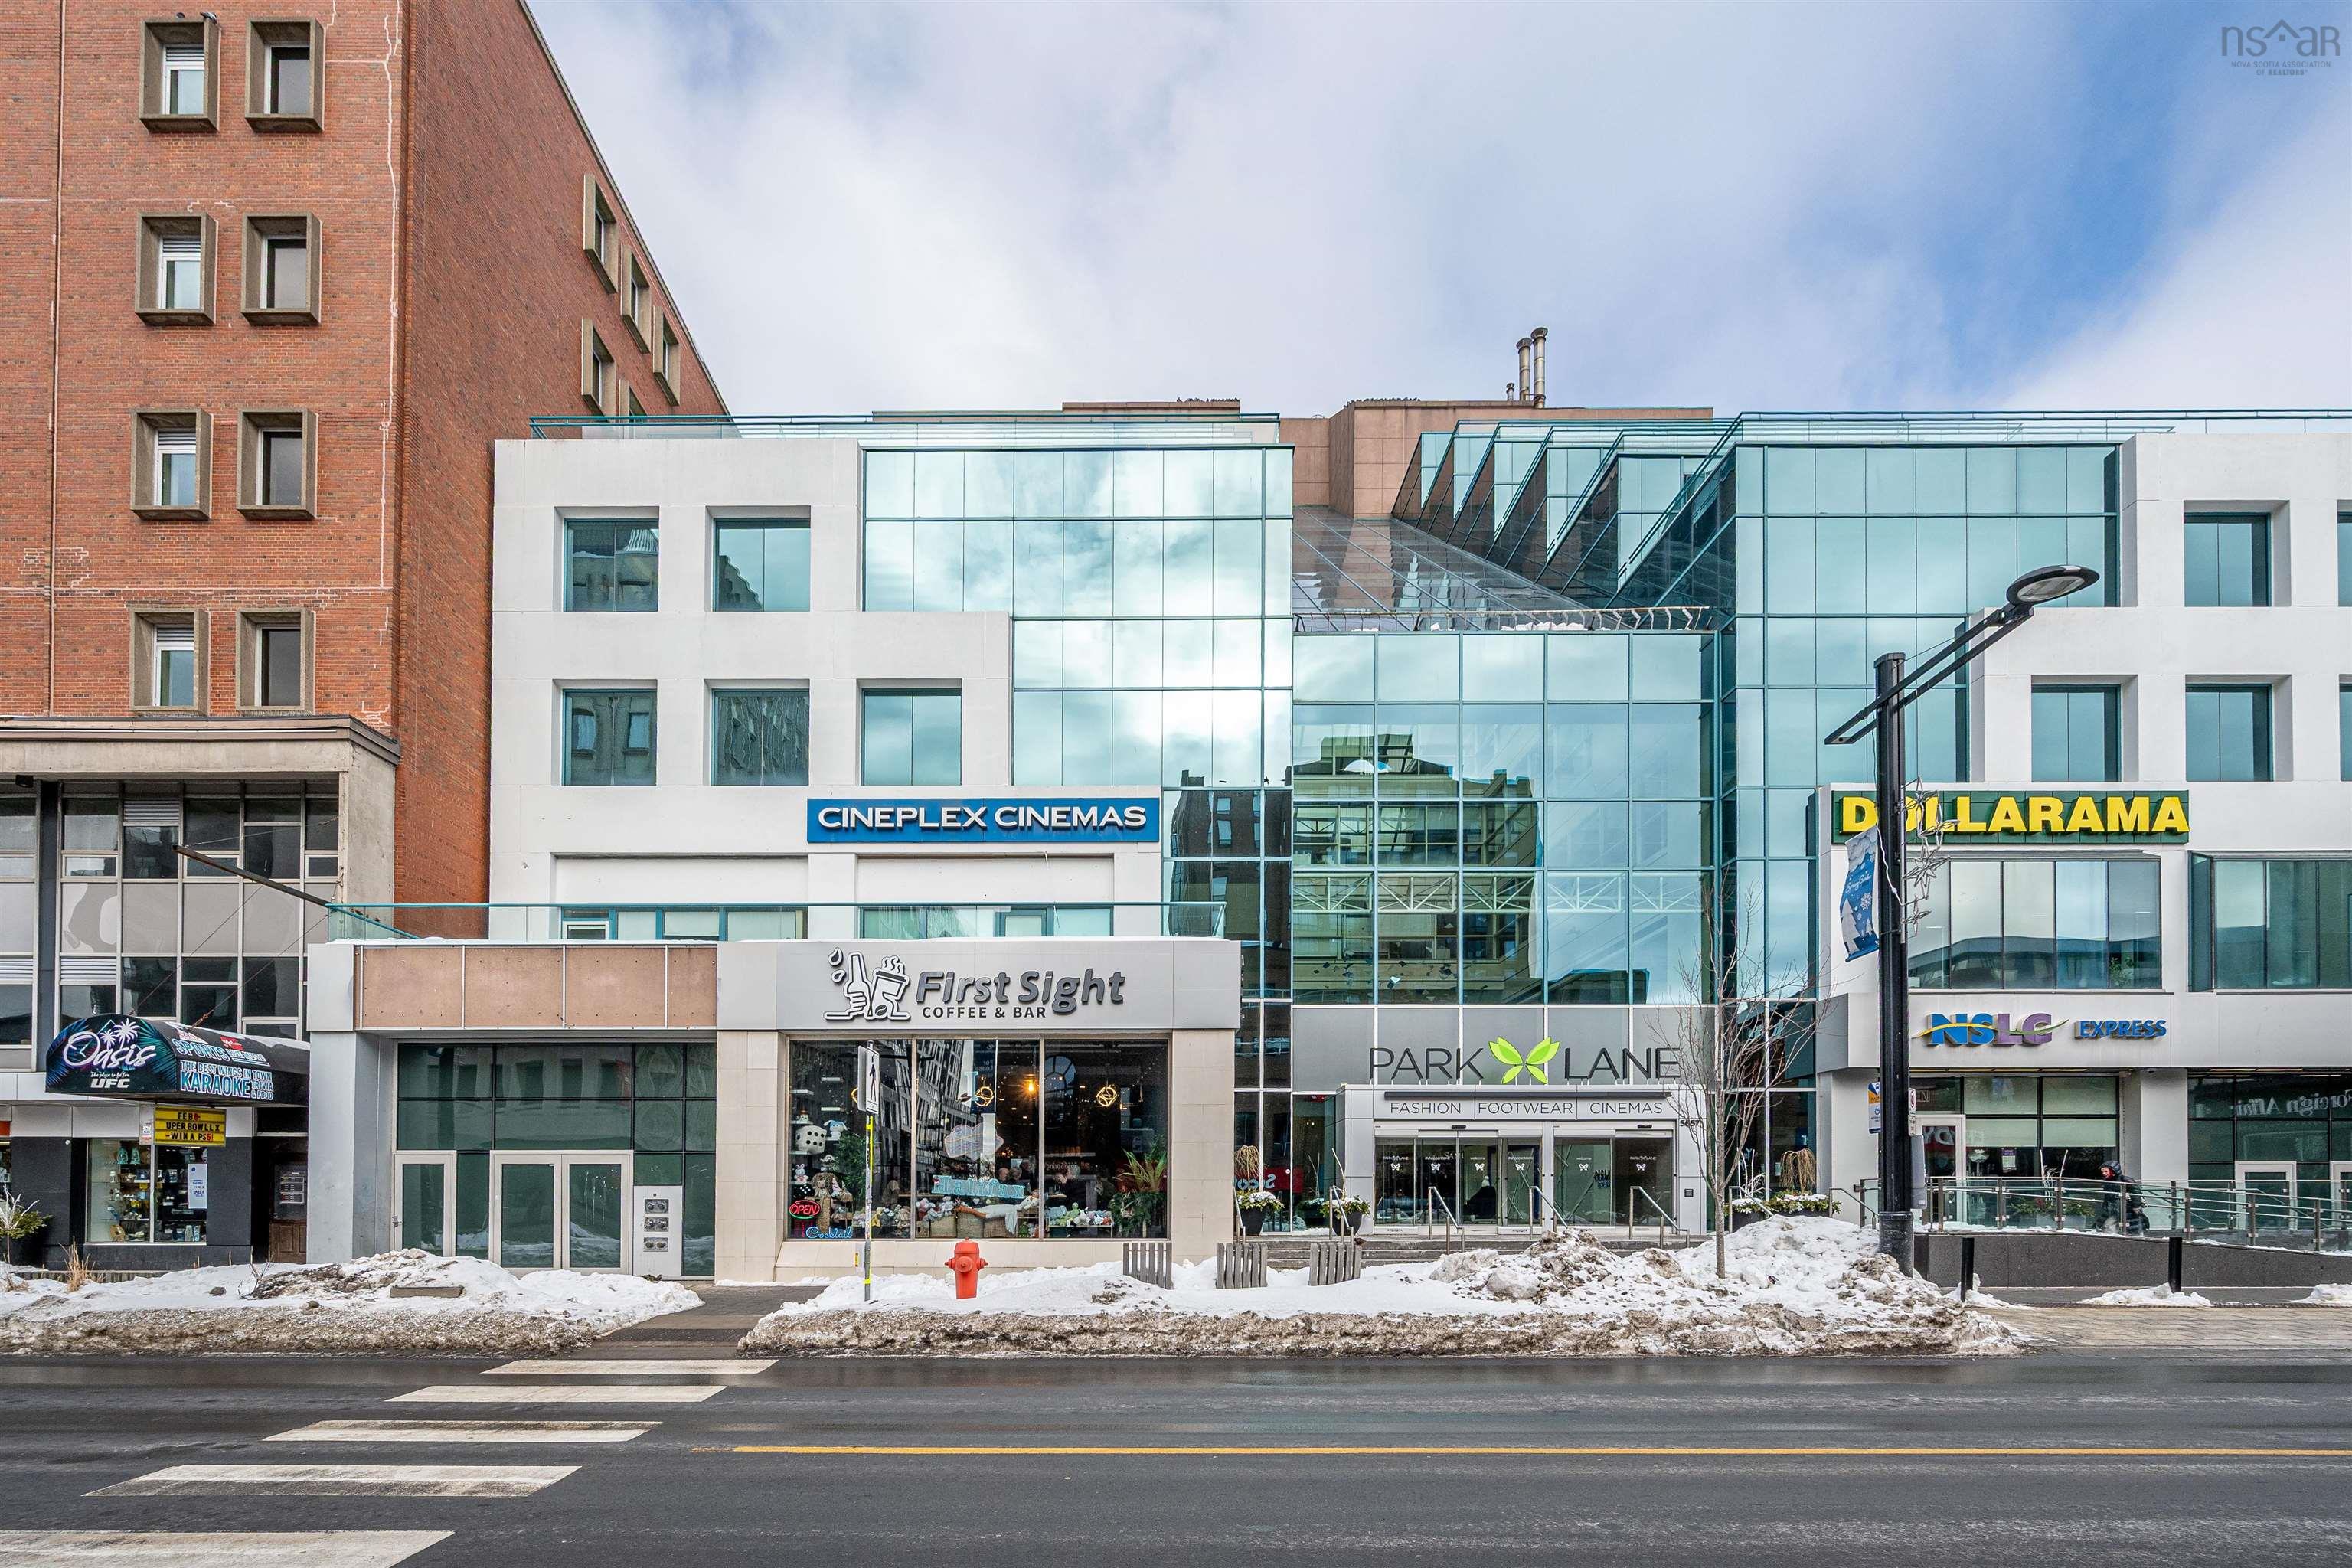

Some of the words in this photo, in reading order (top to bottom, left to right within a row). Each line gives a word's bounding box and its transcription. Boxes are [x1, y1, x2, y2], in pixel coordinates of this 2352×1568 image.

[817, 806, 988, 829] CINEPLEX
[994, 806, 1148, 828] CINEMAS
[915, 971, 1011, 1004] First
[1017, 968, 1125, 1014] Sight
[922, 1007, 987, 1018] COFFEE
[994, 1007, 1005, 1018] &
[1013, 1007, 1047, 1018] BAR
[2076, 1018, 2167, 1039] EXPRESS
[63, 1031, 157, 1069] Oasis
[172, 1038, 230, 1062] SPORTS
[180, 1060, 197, 1072] THE
[198, 1061, 217, 1075] BEST
[217, 1063, 242, 1078] WINGS
[243, 1068, 252, 1079] IN
[252, 1069, 273, 1082] TOWN
[1369, 1047, 1485, 1079] PARK
[1564, 1047, 1682, 1079] LANE
[90, 1078, 130, 1089] UFC
[180, 1070, 251, 1099] KARAOKE
[250, 1079, 274, 1092] TRIVIA
[256, 1091, 274, 1101] FOOD
[1390, 1102, 1462, 1115] FASHION
[1478, 1102, 1573, 1115] FOOTWEAR
[1589, 1102, 1663, 1115] CINEMAS
[931, 1174, 1026, 1200] Halifax
[790, 1204, 818, 1215] OPEN
[805, 1226, 853, 1239] Cocktail
